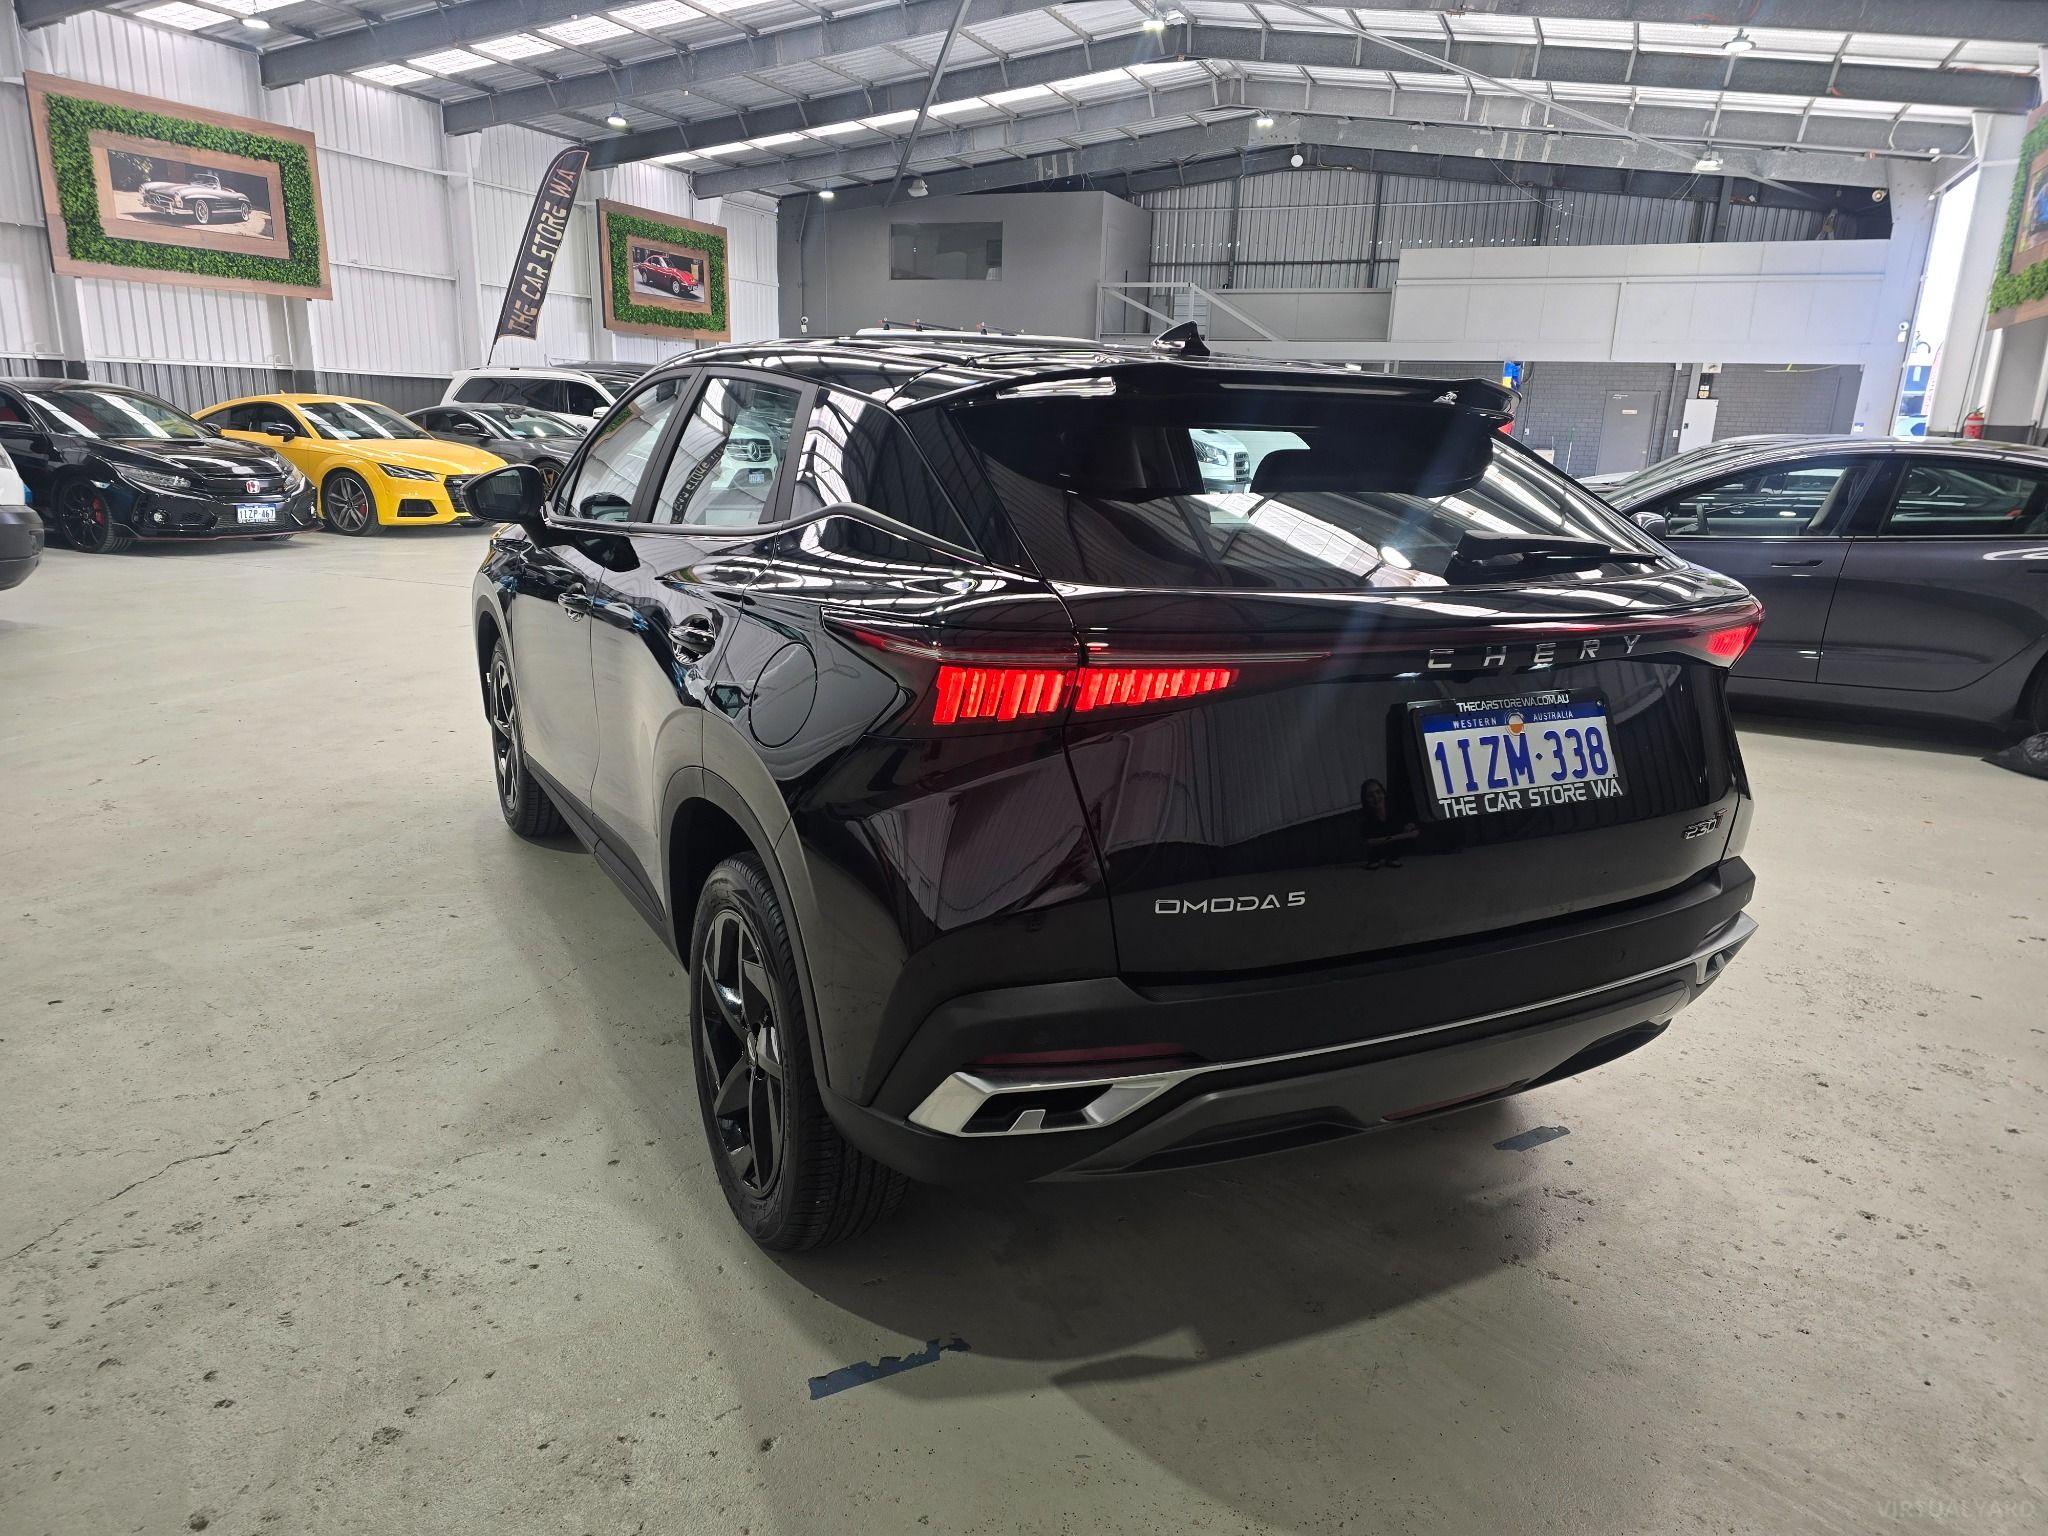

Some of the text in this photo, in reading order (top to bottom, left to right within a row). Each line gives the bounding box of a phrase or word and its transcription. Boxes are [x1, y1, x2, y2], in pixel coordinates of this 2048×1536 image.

[508, 169, 577, 334] THE CAR STORE WA
[1427, 634, 1641, 669] CHERY
[1456, 694, 1570, 713] THECARSTOREWA.COM.AU
[1453, 711, 1574, 730] WESTERN AUSTRALIA
[1438, 778, 1624, 819] THE CAR STORE WA
[1154, 891, 1306, 914] OMODA 5
